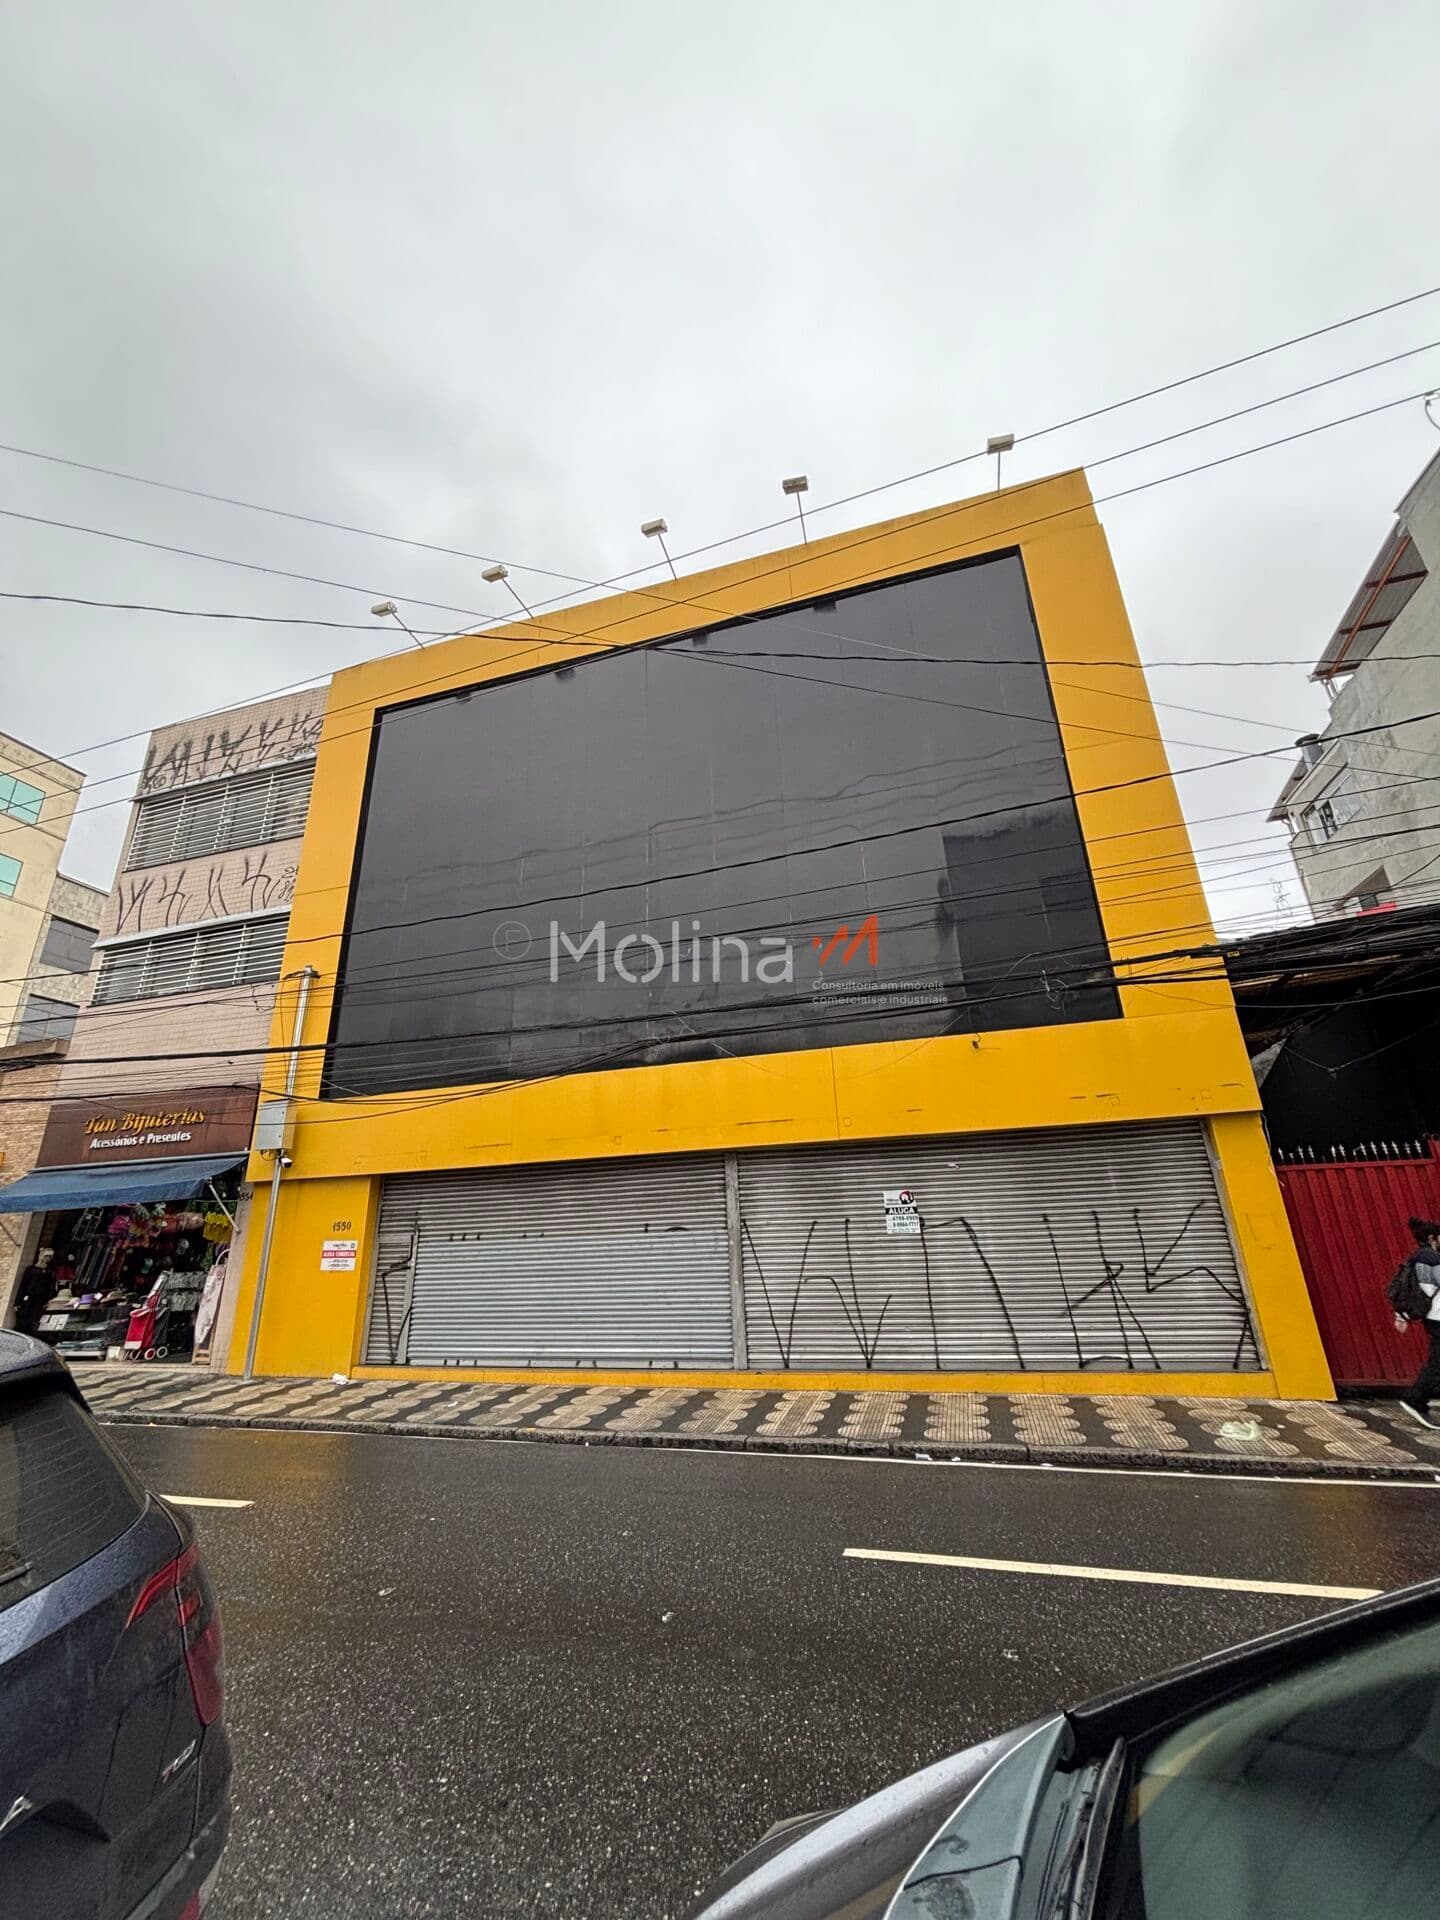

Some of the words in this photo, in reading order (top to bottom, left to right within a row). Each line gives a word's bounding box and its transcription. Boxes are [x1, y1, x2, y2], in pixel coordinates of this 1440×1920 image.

[121, 1106, 206, 1136] Bijuterias
[90, 1135, 137, 1149] Acessórios
[138, 1135, 146, 1144] e
[146, 1131, 192, 1145] Presentes
[332, 1220, 352, 1232] 1550
